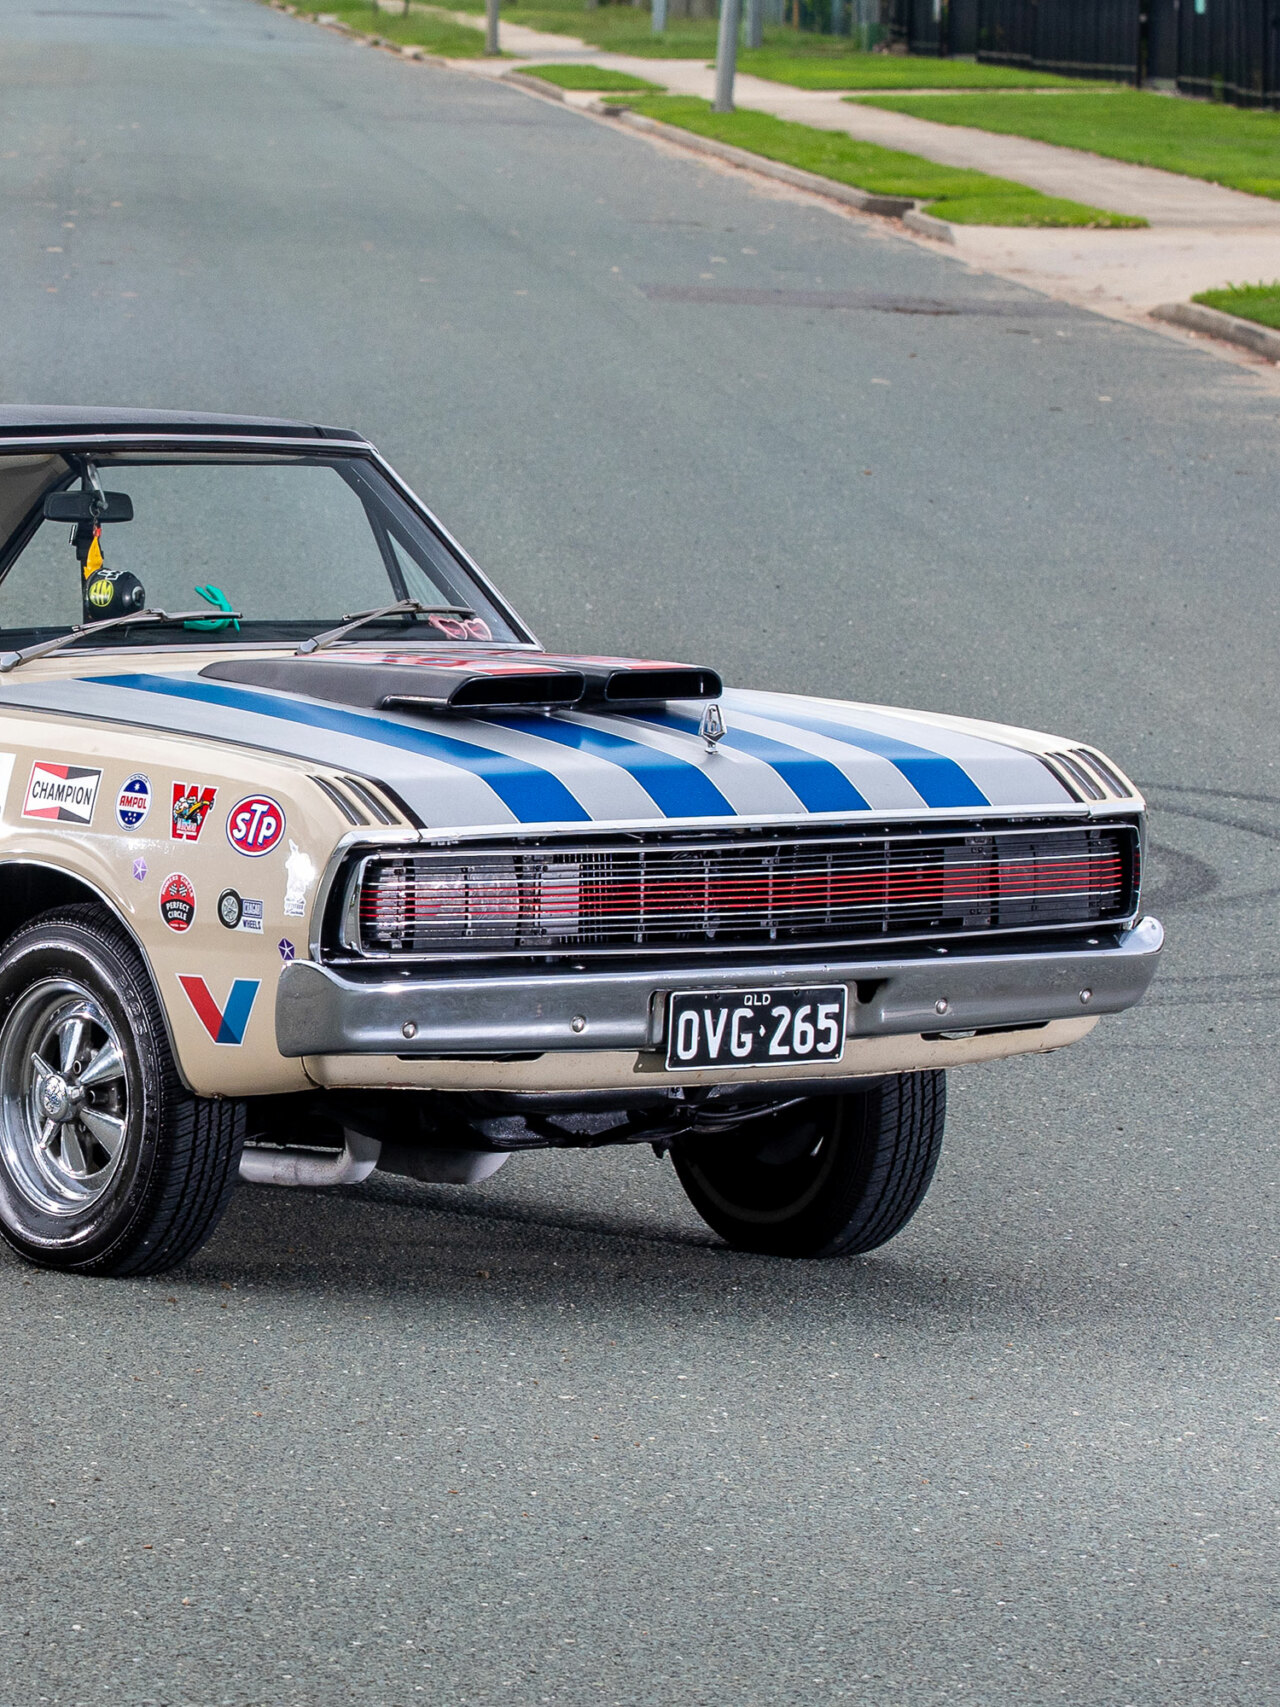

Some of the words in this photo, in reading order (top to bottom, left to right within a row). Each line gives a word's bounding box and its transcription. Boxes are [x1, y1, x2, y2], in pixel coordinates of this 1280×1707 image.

[32, 780, 93, 805] CHAMPION
[120, 795, 147, 809] AMPOL
[232, 803, 277, 846] STP
[166, 901, 189, 912] PERFECT
[168, 910, 187, 920] CIRCLE
[743, 993, 771, 1006] QLD
[677, 1007, 754, 1060] OVG
[769, 1003, 840, 1055] 265
